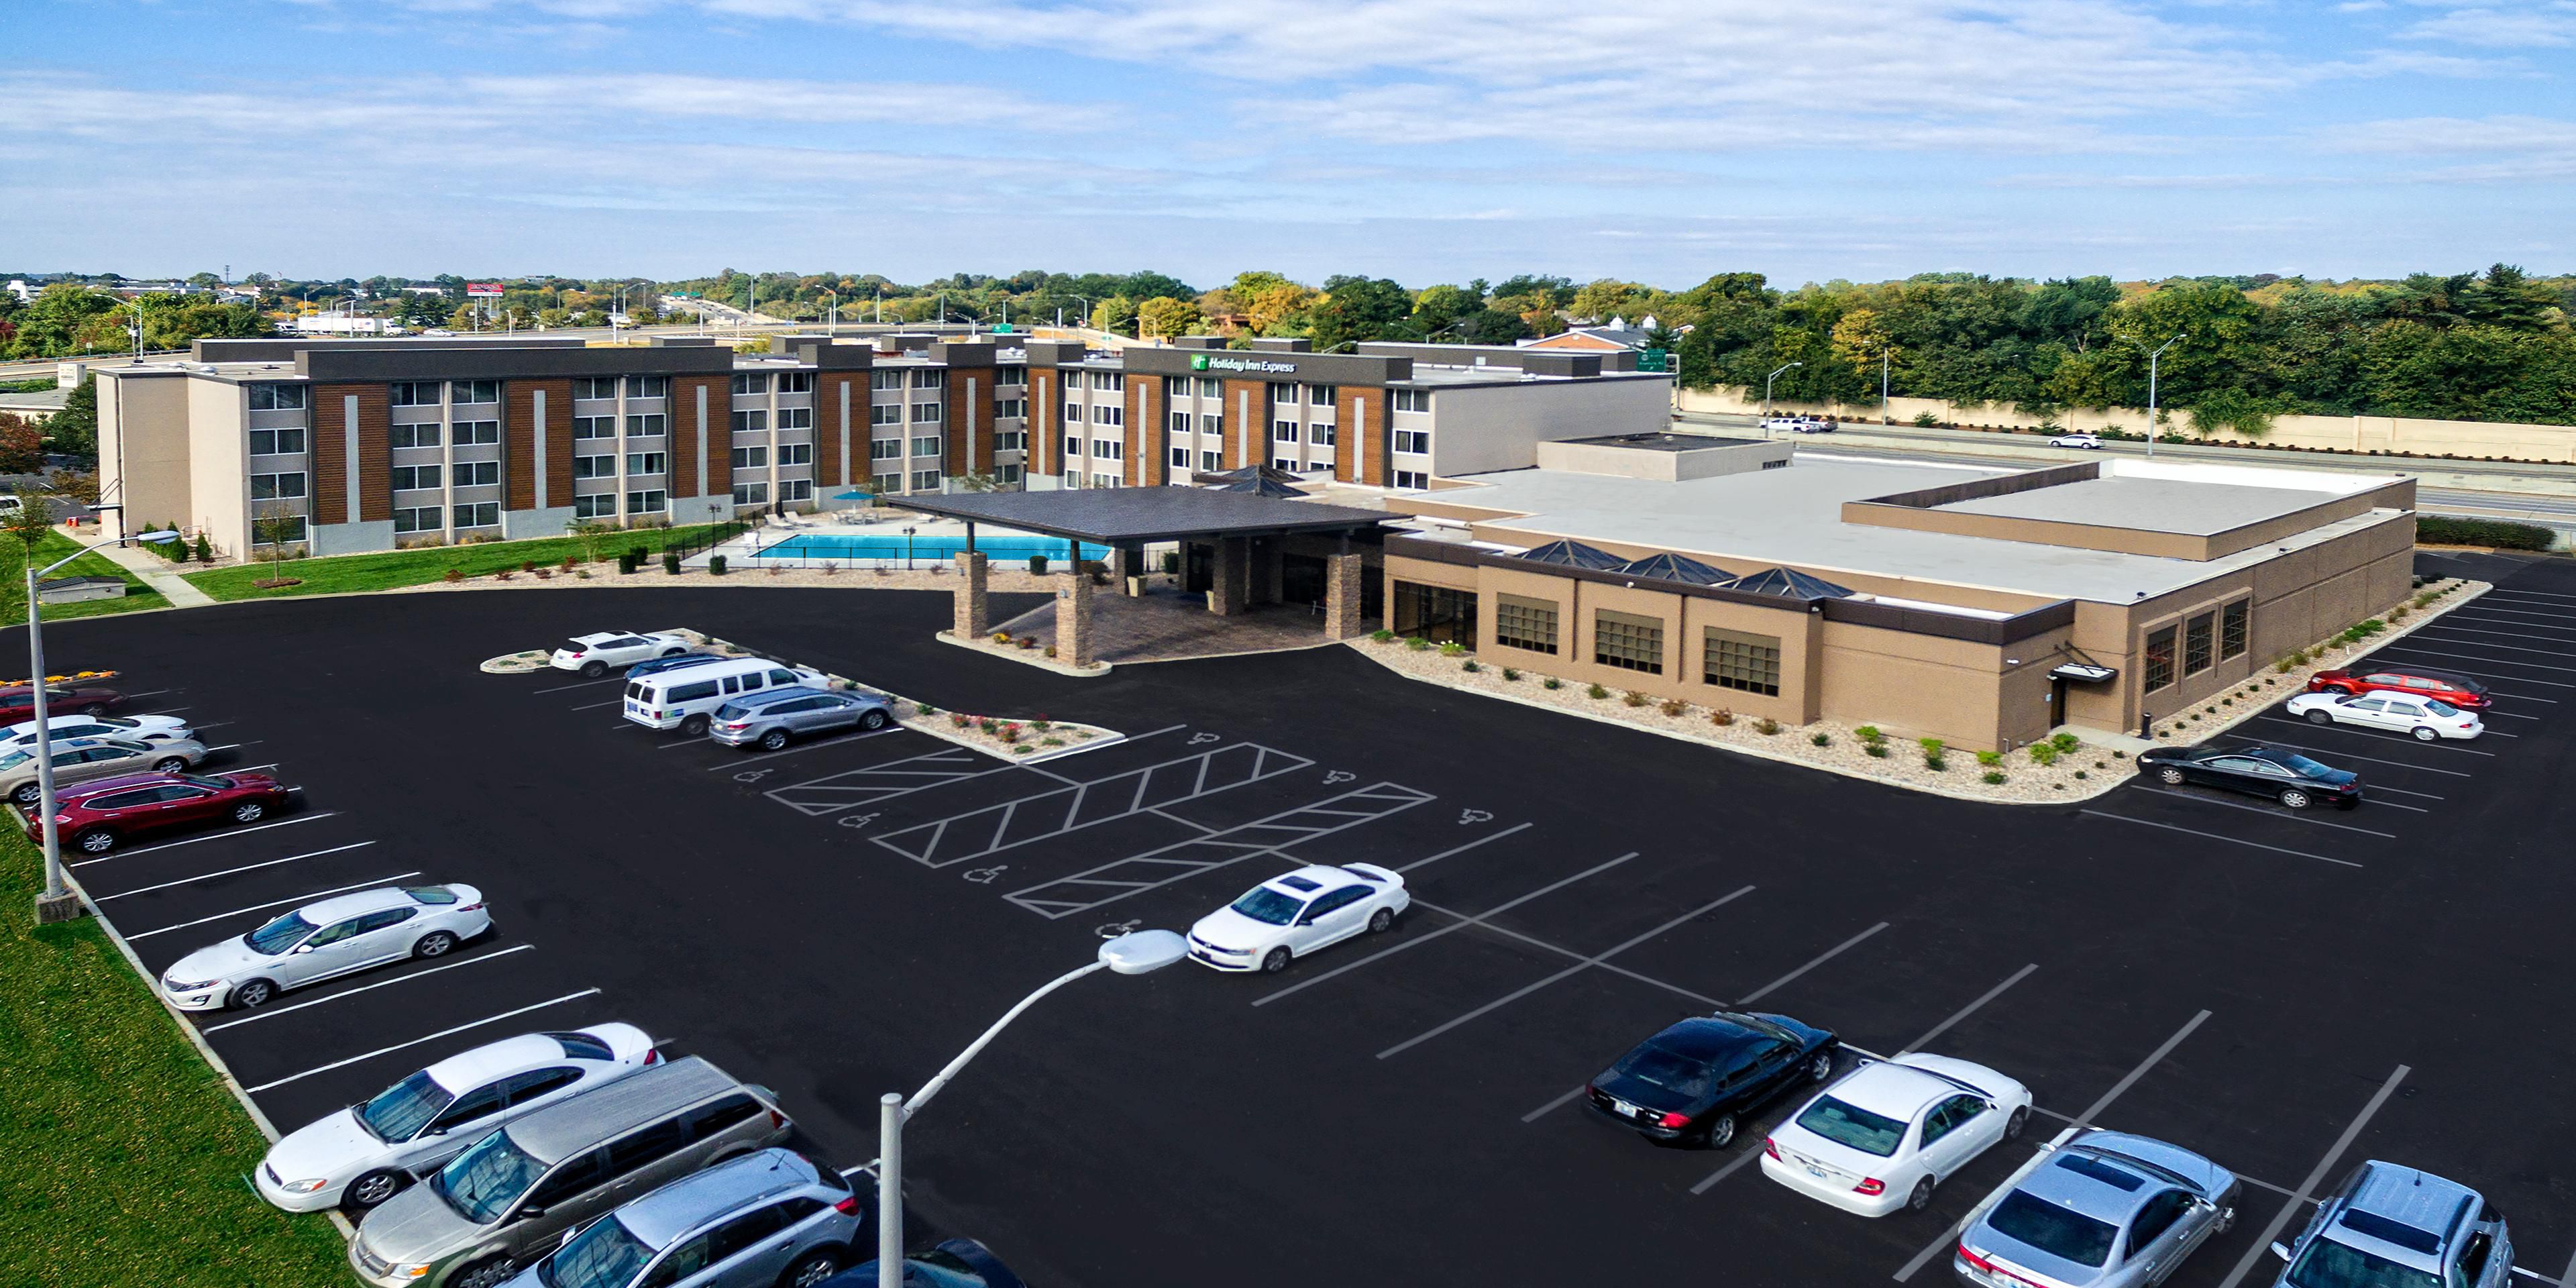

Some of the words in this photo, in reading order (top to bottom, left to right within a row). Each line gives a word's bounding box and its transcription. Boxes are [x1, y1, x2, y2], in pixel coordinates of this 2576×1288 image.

[1209, 357, 1244, 372] Holiday
[1245, 359, 1261, 371] Inn
[1261, 361, 1295, 373] Express
